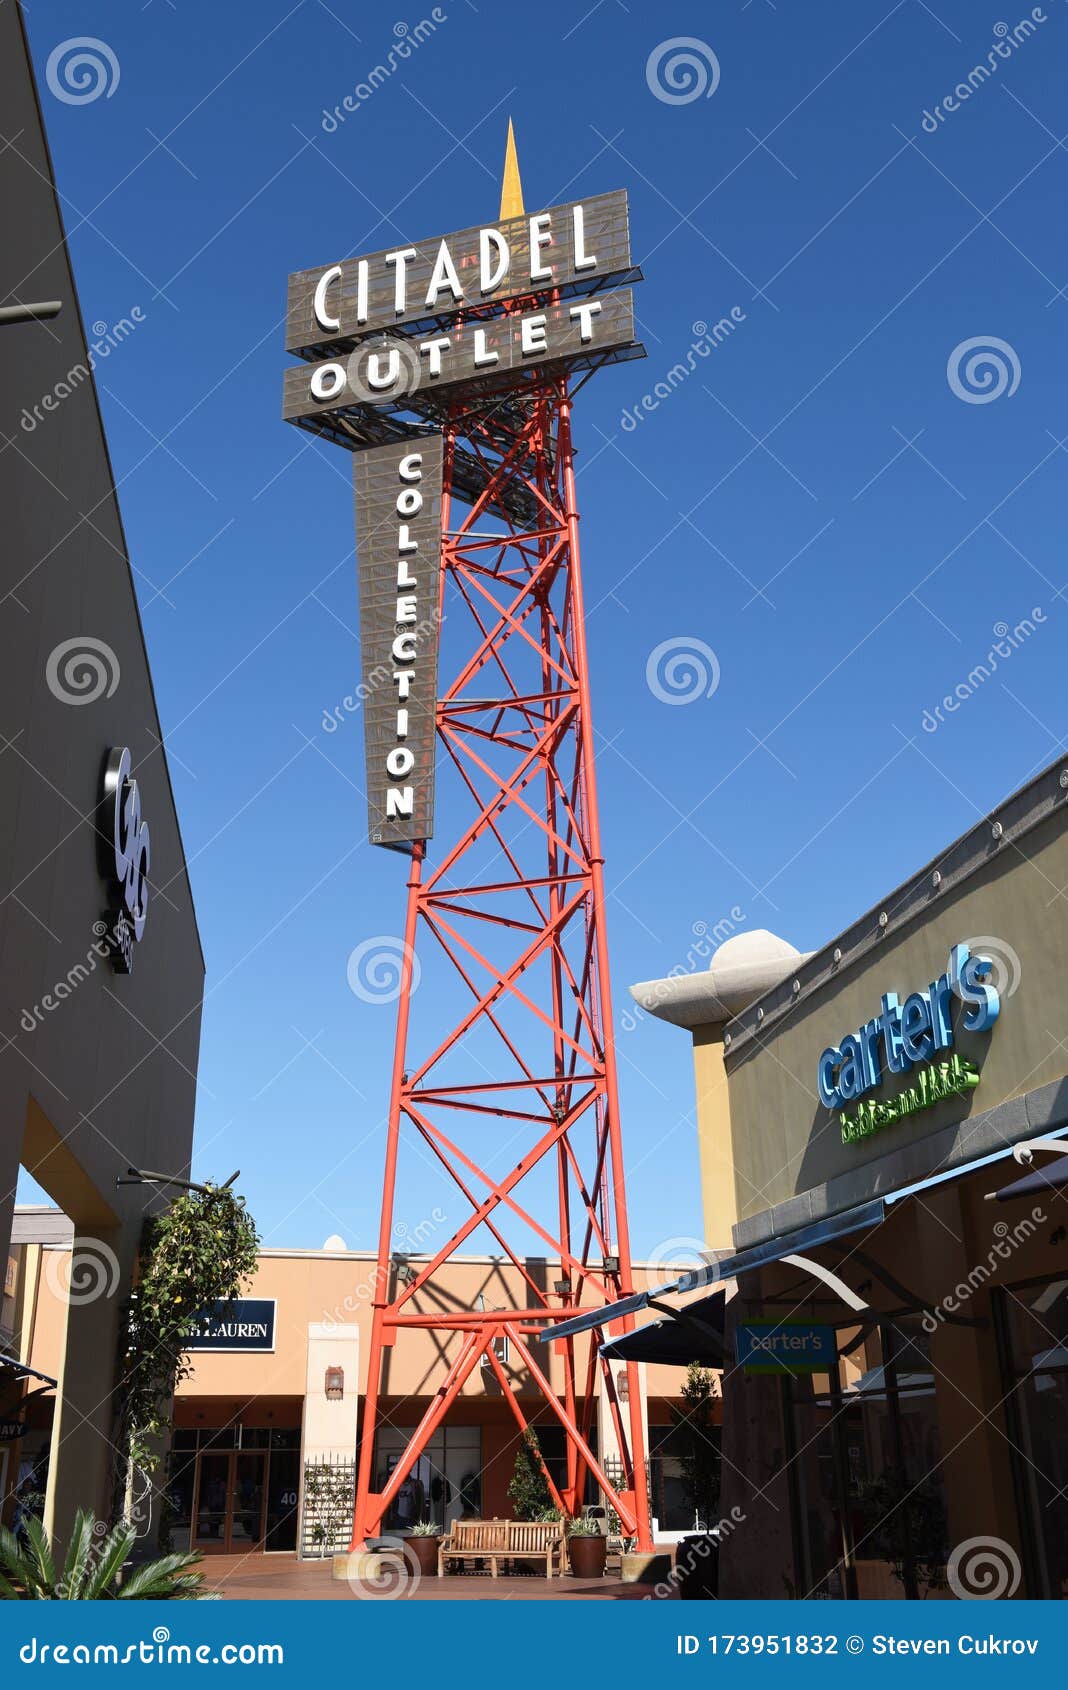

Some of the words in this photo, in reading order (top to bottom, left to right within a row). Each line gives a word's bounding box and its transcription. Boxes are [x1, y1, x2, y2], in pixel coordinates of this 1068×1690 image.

[313, 204, 597, 331] CITADEL
[310, 301, 602, 400] OUTLET
[386, 453, 423, 820] COLLECTION
[817, 944, 1001, 1109] carter's
[750, 1332, 823, 1351] carter's
